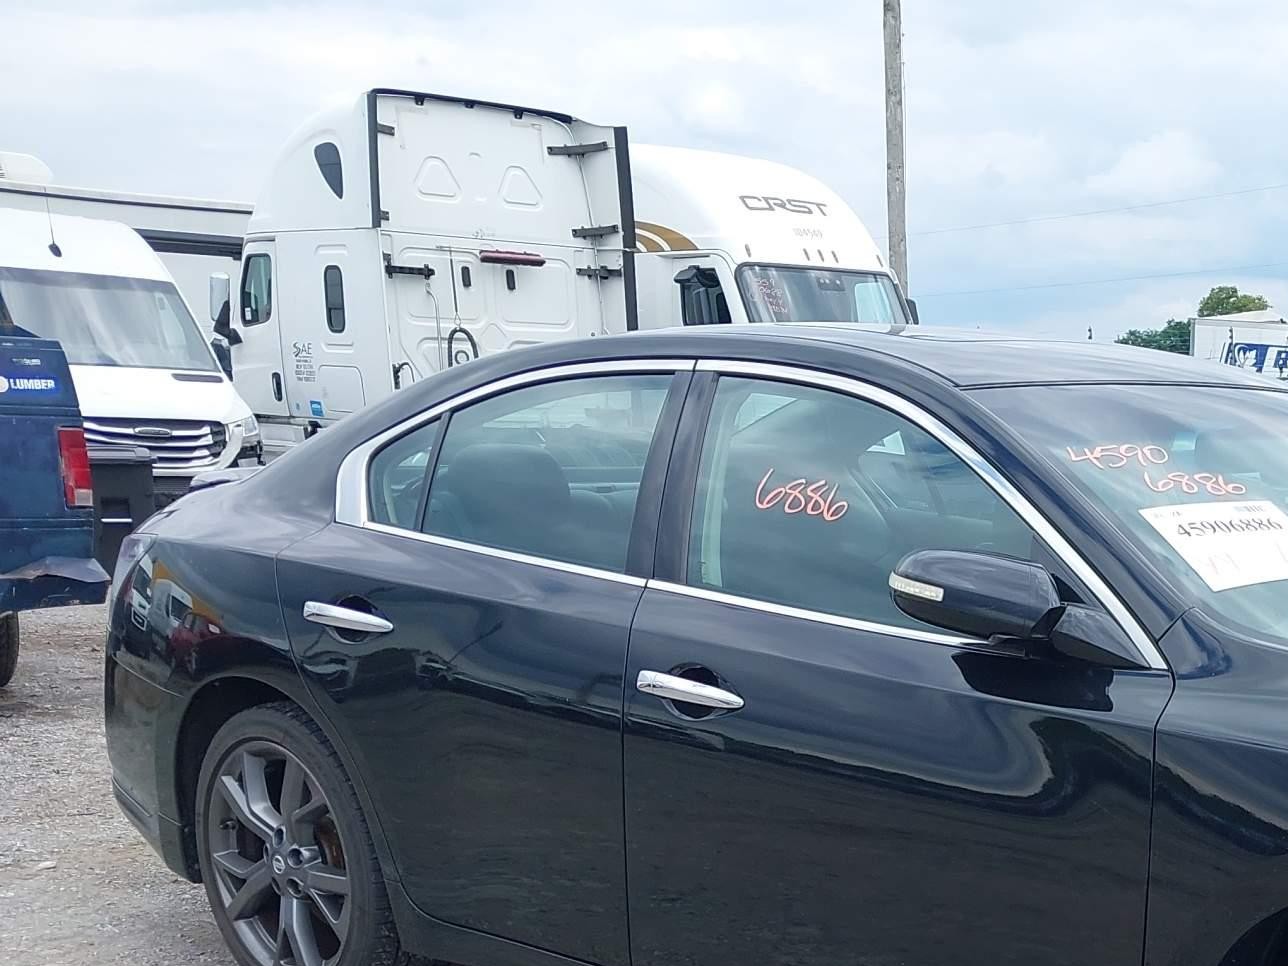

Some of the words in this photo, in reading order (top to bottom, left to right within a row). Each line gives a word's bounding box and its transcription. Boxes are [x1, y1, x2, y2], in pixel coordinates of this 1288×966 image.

[739, 195, 827, 216] CRST
[9, 378, 56, 390] LUMBER
[1066, 444, 1169, 470] 4590
[755, 467, 849, 521] 6886
[1144, 471, 1247, 495] 6886
[1176, 517, 1284, 538] 45906886
